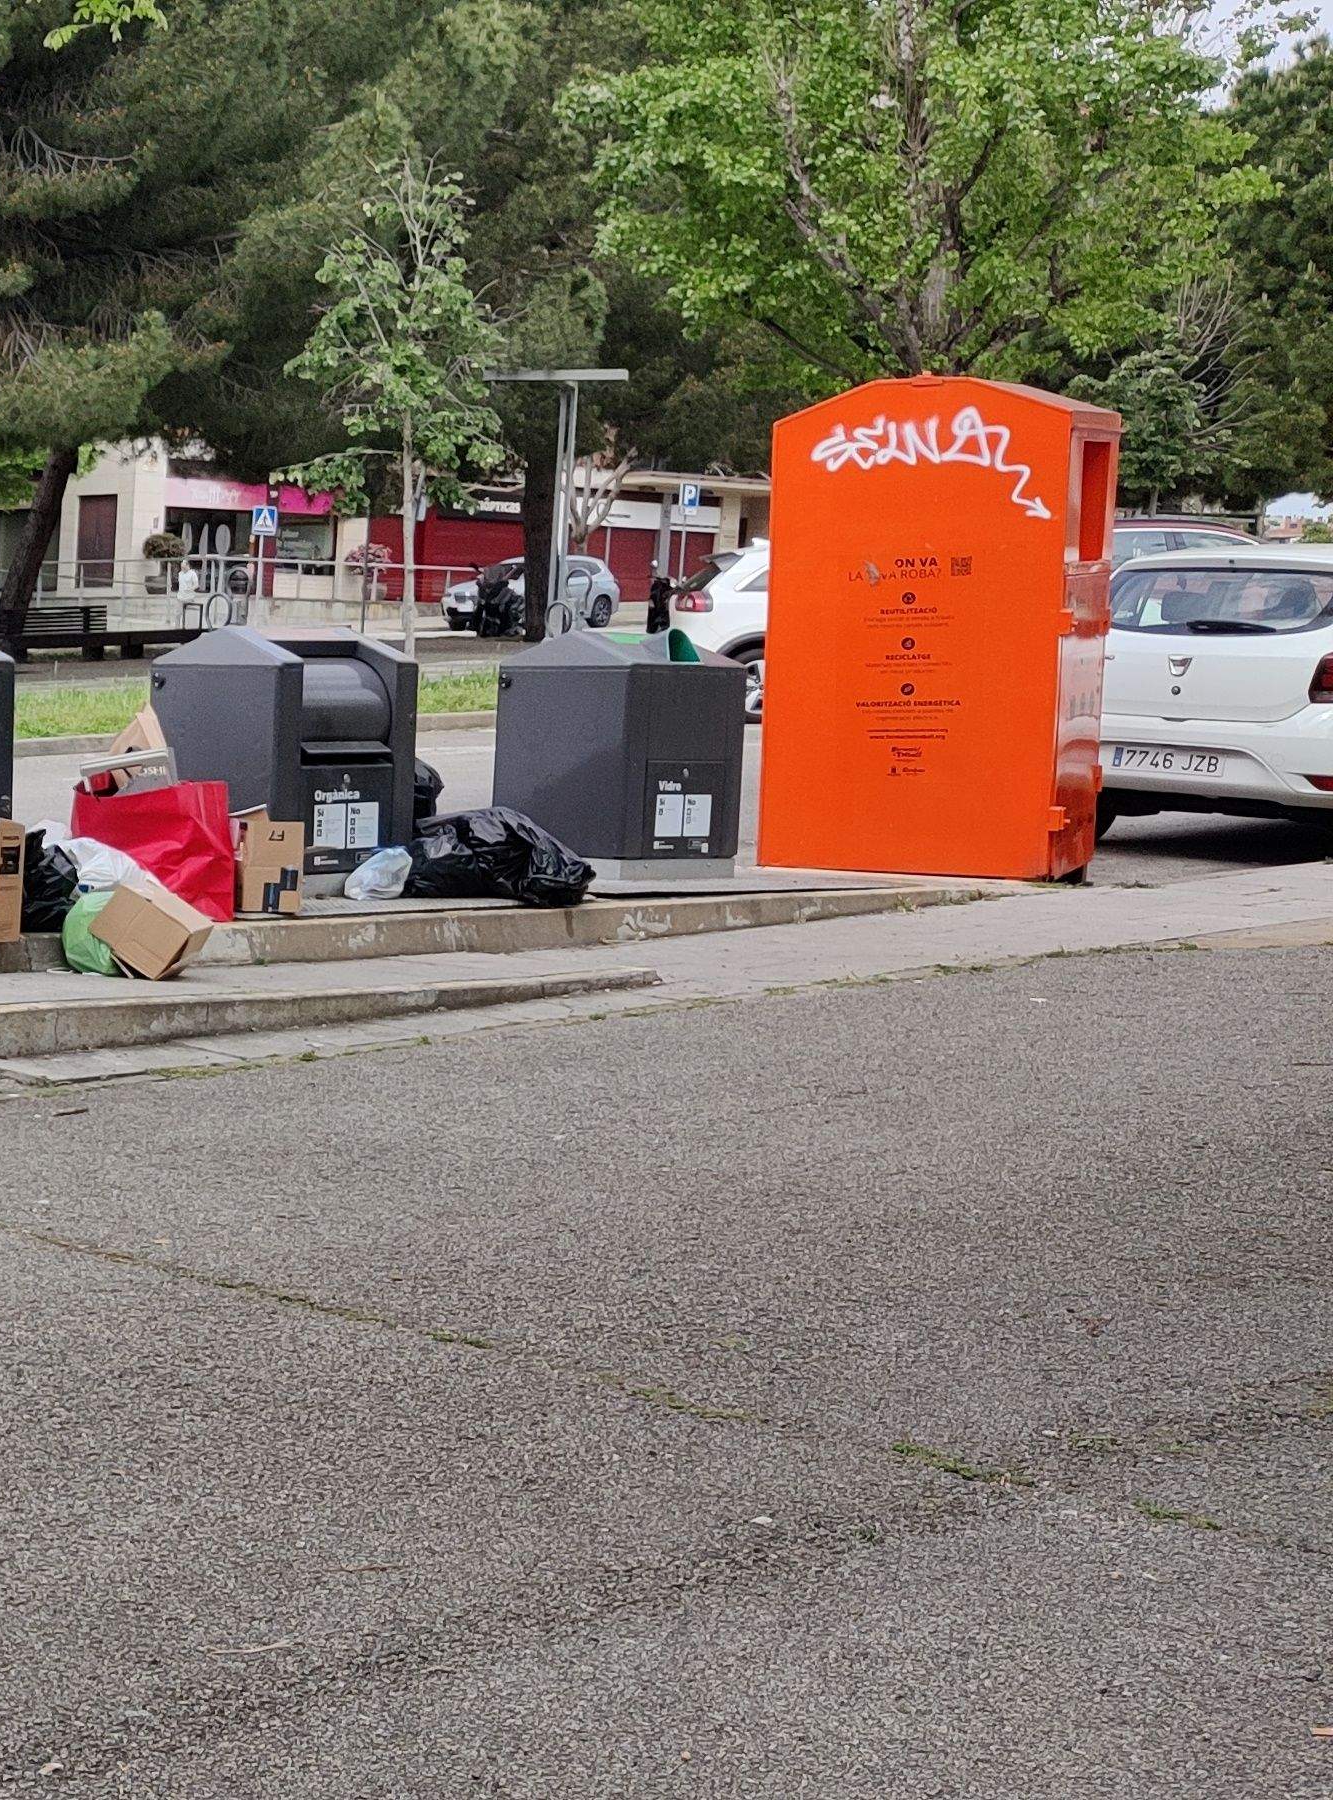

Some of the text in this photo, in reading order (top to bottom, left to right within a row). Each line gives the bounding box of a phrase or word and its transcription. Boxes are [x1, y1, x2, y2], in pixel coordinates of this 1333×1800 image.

[895, 557, 938, 568] ON VA
[848, 571, 864, 582] LA
[900, 568, 941, 580] ROBA?
[1124, 749, 1219, 773] 7746 JZB
[314, 788, 360, 803] Orgànica
